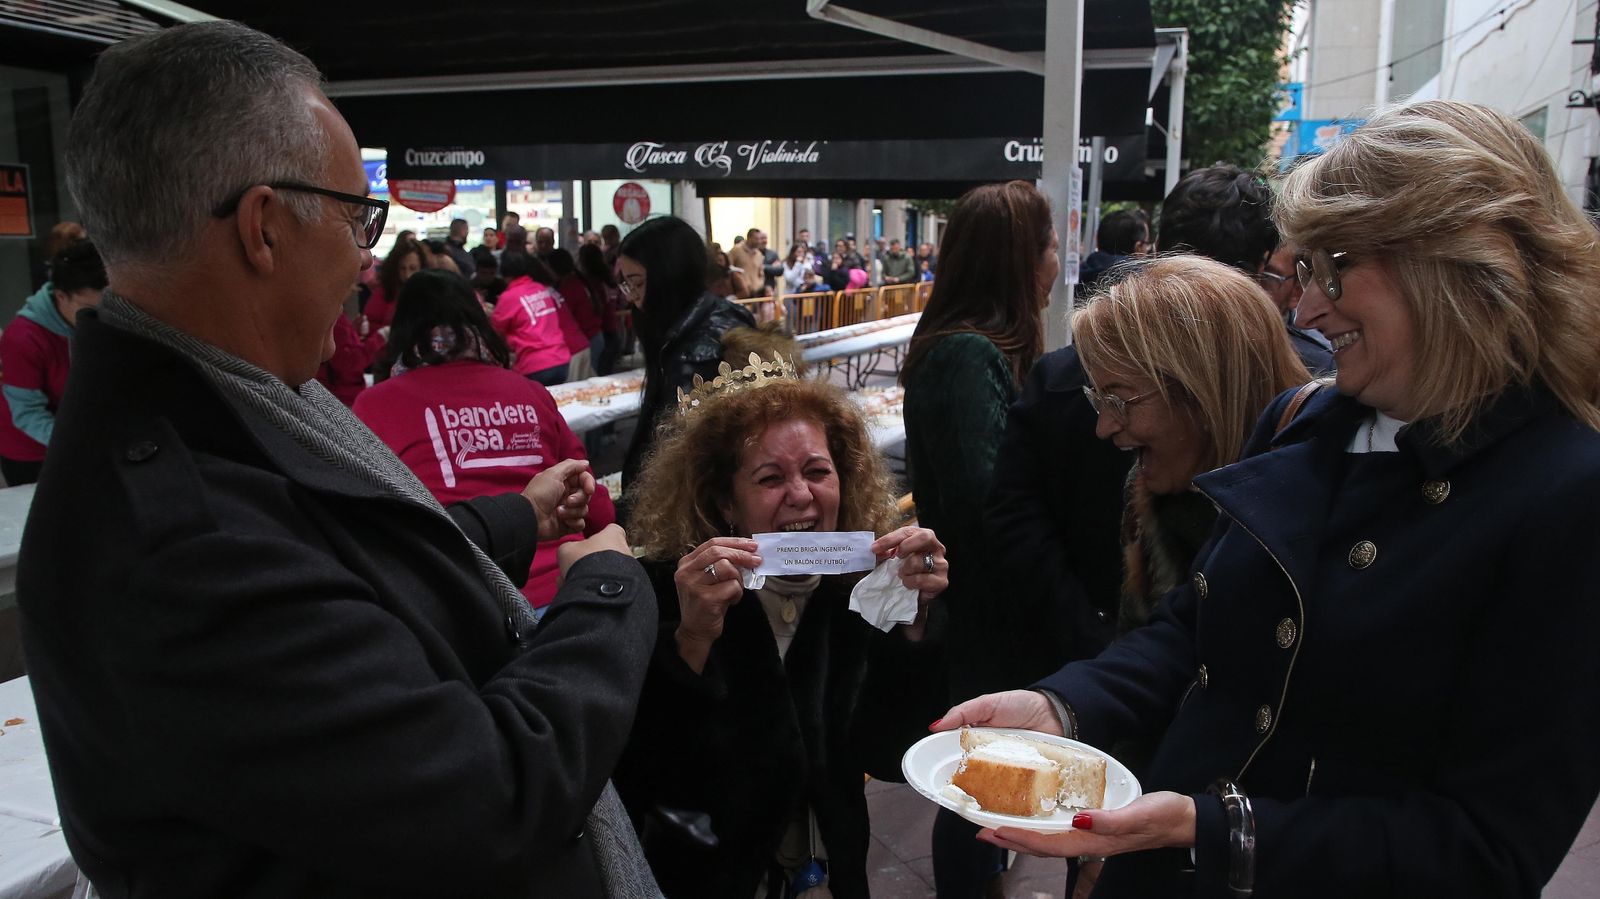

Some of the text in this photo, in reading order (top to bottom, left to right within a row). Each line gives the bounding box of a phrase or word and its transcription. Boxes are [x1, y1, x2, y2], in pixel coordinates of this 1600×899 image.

[404, 148, 485, 169] Cruzcampo
[624, 140, 821, 178] Tasca El Violinista
[1004, 140, 1119, 164] Crumo
[439, 402, 539, 429] bandera
[447, 427, 505, 455] rosa
